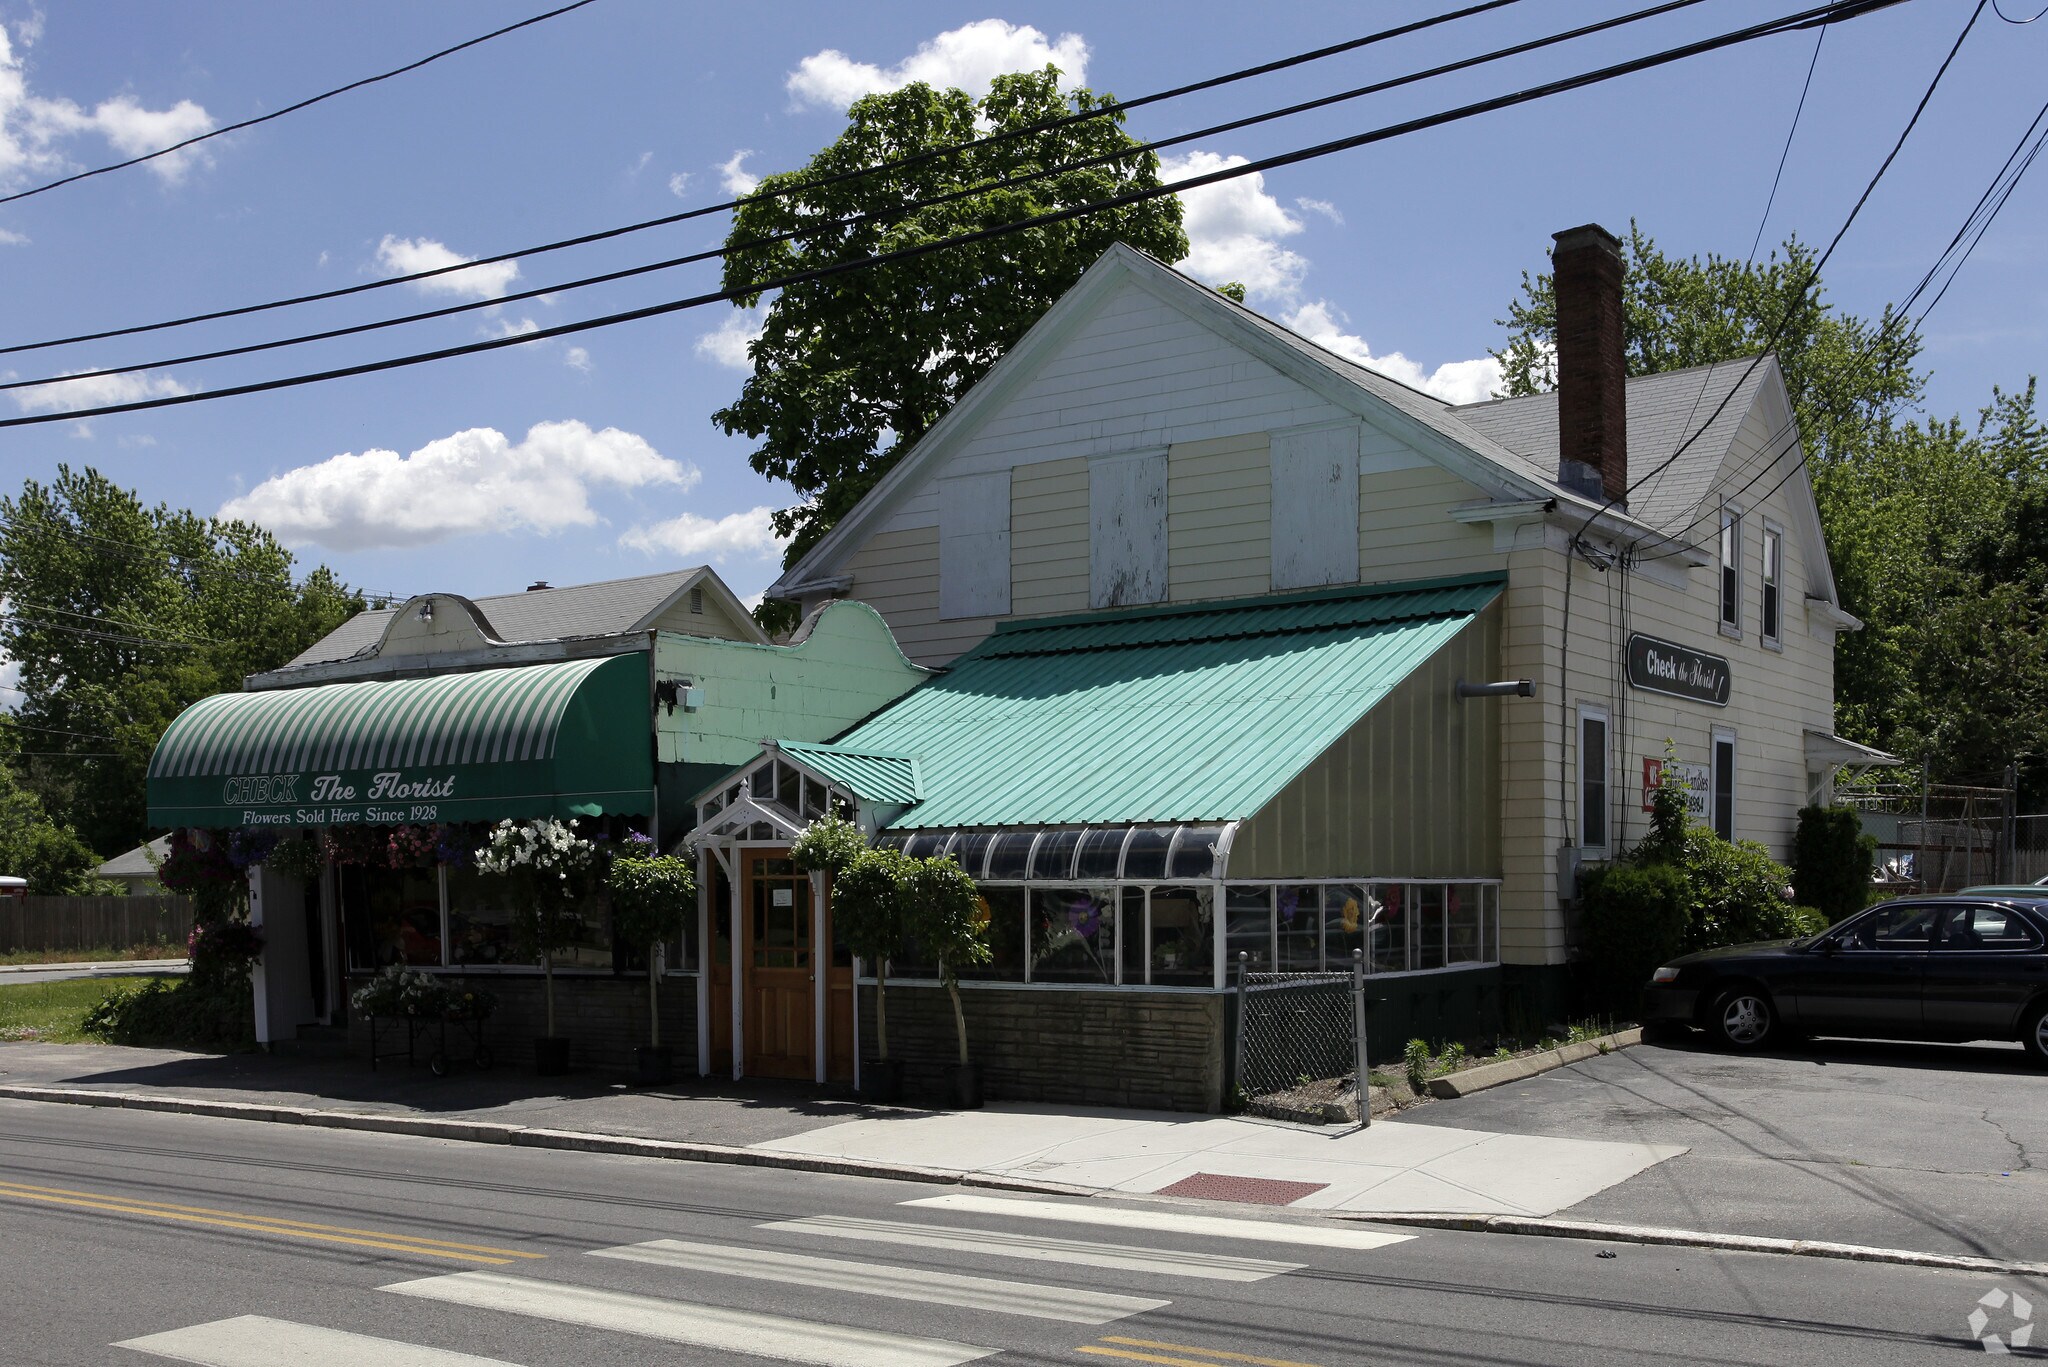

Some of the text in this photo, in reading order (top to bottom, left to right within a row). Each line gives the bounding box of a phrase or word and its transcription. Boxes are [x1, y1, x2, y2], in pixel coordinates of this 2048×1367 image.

[1647, 649, 1716, 689] Check the Florist
[224, 772, 456, 805] CHECK The Florist
[242, 805, 437, 825] Flowers Sold Here Since 1928
